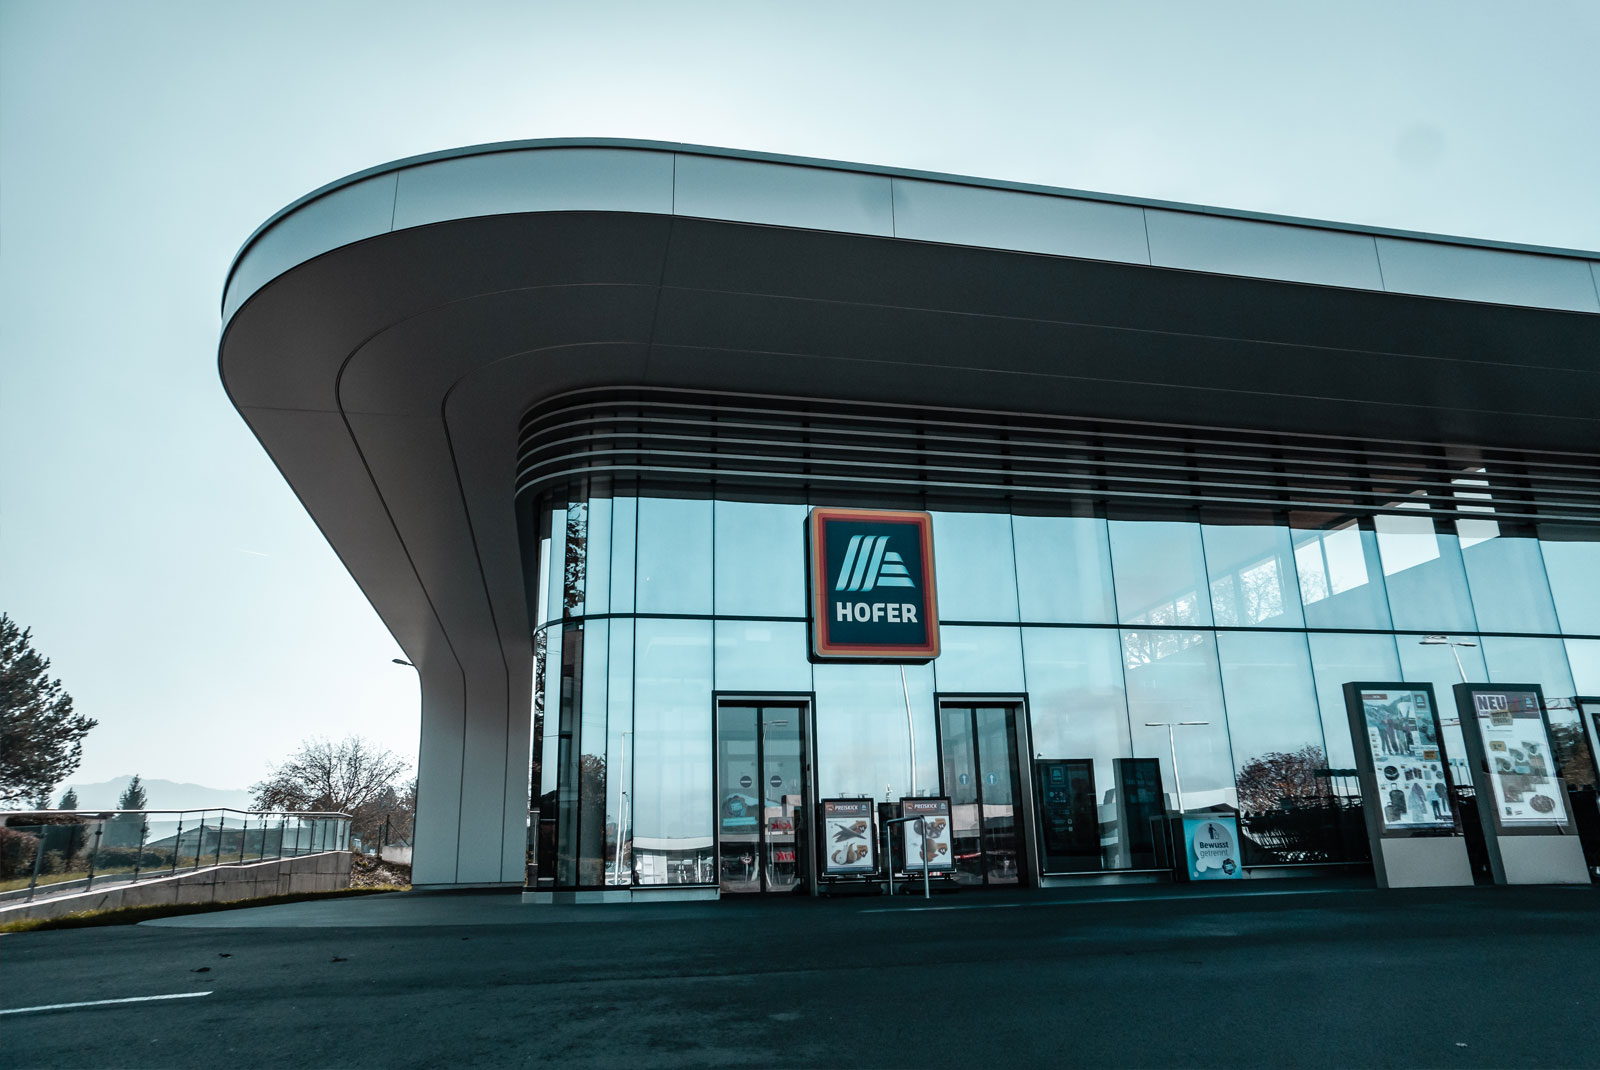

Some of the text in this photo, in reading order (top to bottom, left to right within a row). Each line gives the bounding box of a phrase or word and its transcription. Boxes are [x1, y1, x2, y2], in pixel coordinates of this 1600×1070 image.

[836, 602, 918, 623] HOFER
[1476, 695, 1507, 710] NEU
[1199, 841, 1229, 849] Bewusst
[1200, 849, 1228, 859] getrennt
